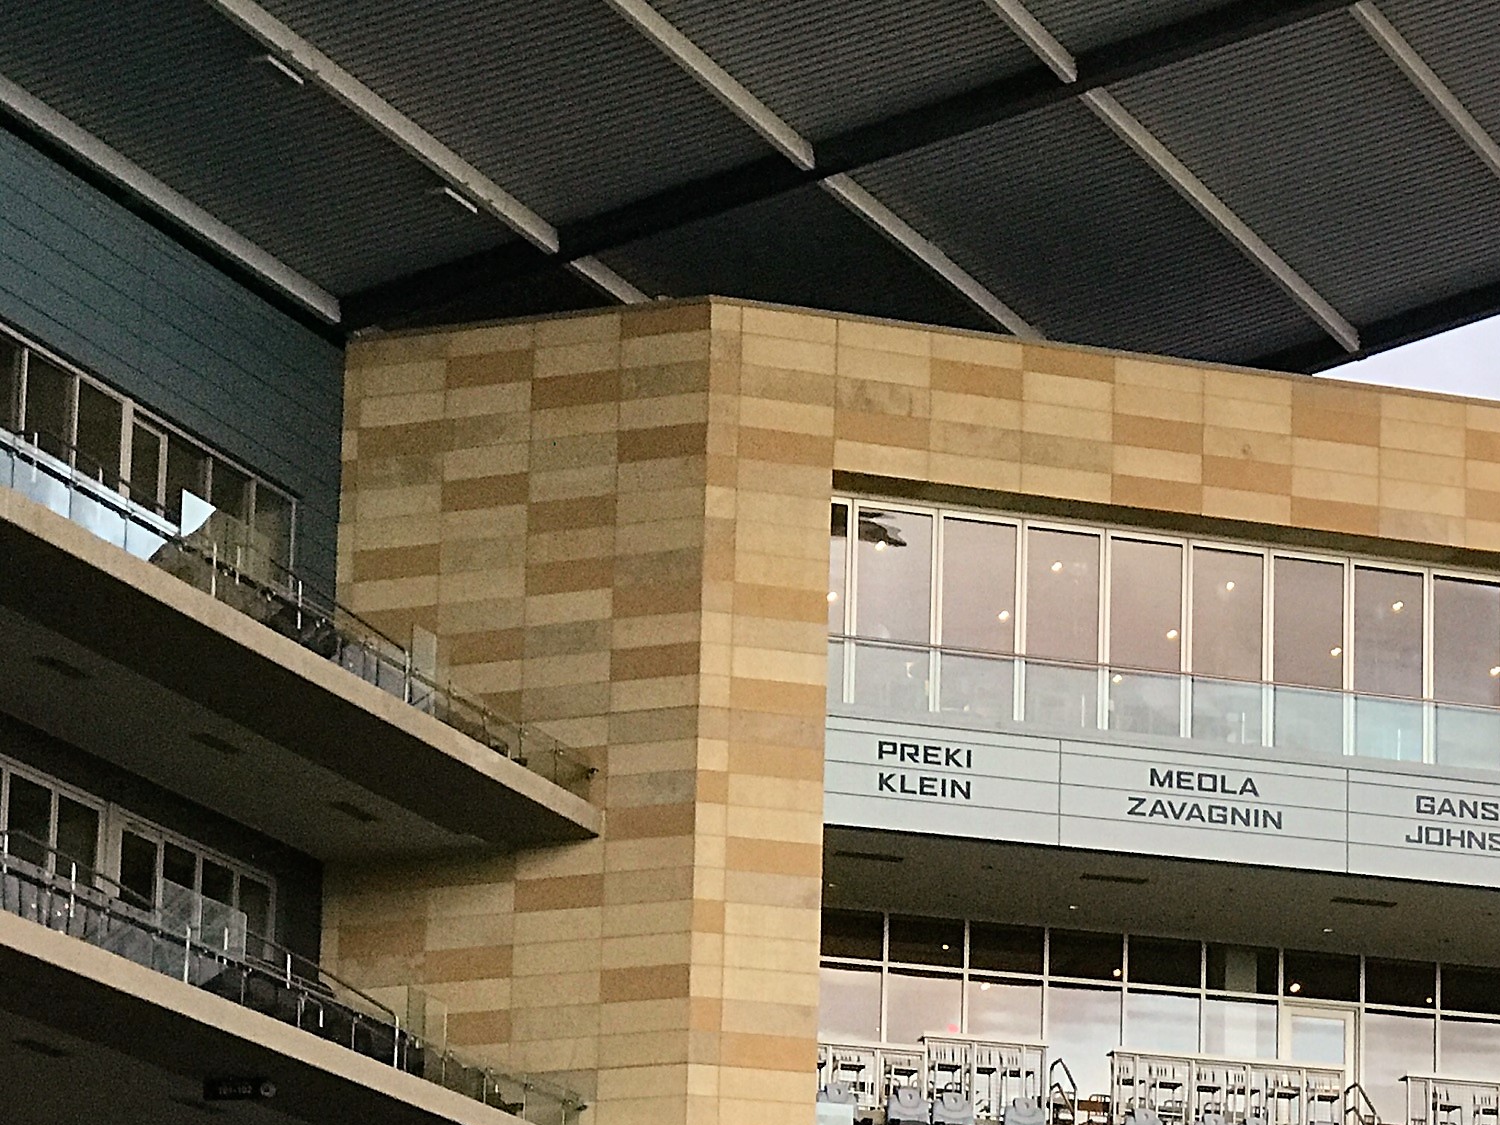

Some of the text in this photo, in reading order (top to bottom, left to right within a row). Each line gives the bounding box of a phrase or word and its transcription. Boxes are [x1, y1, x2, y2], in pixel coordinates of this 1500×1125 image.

[877, 740, 972, 769] PREKI
[877, 772, 972, 801] KLEIN
[1149, 767, 1260, 798] MEOLA
[1126, 796, 1283, 831] ZAVAGNIN
